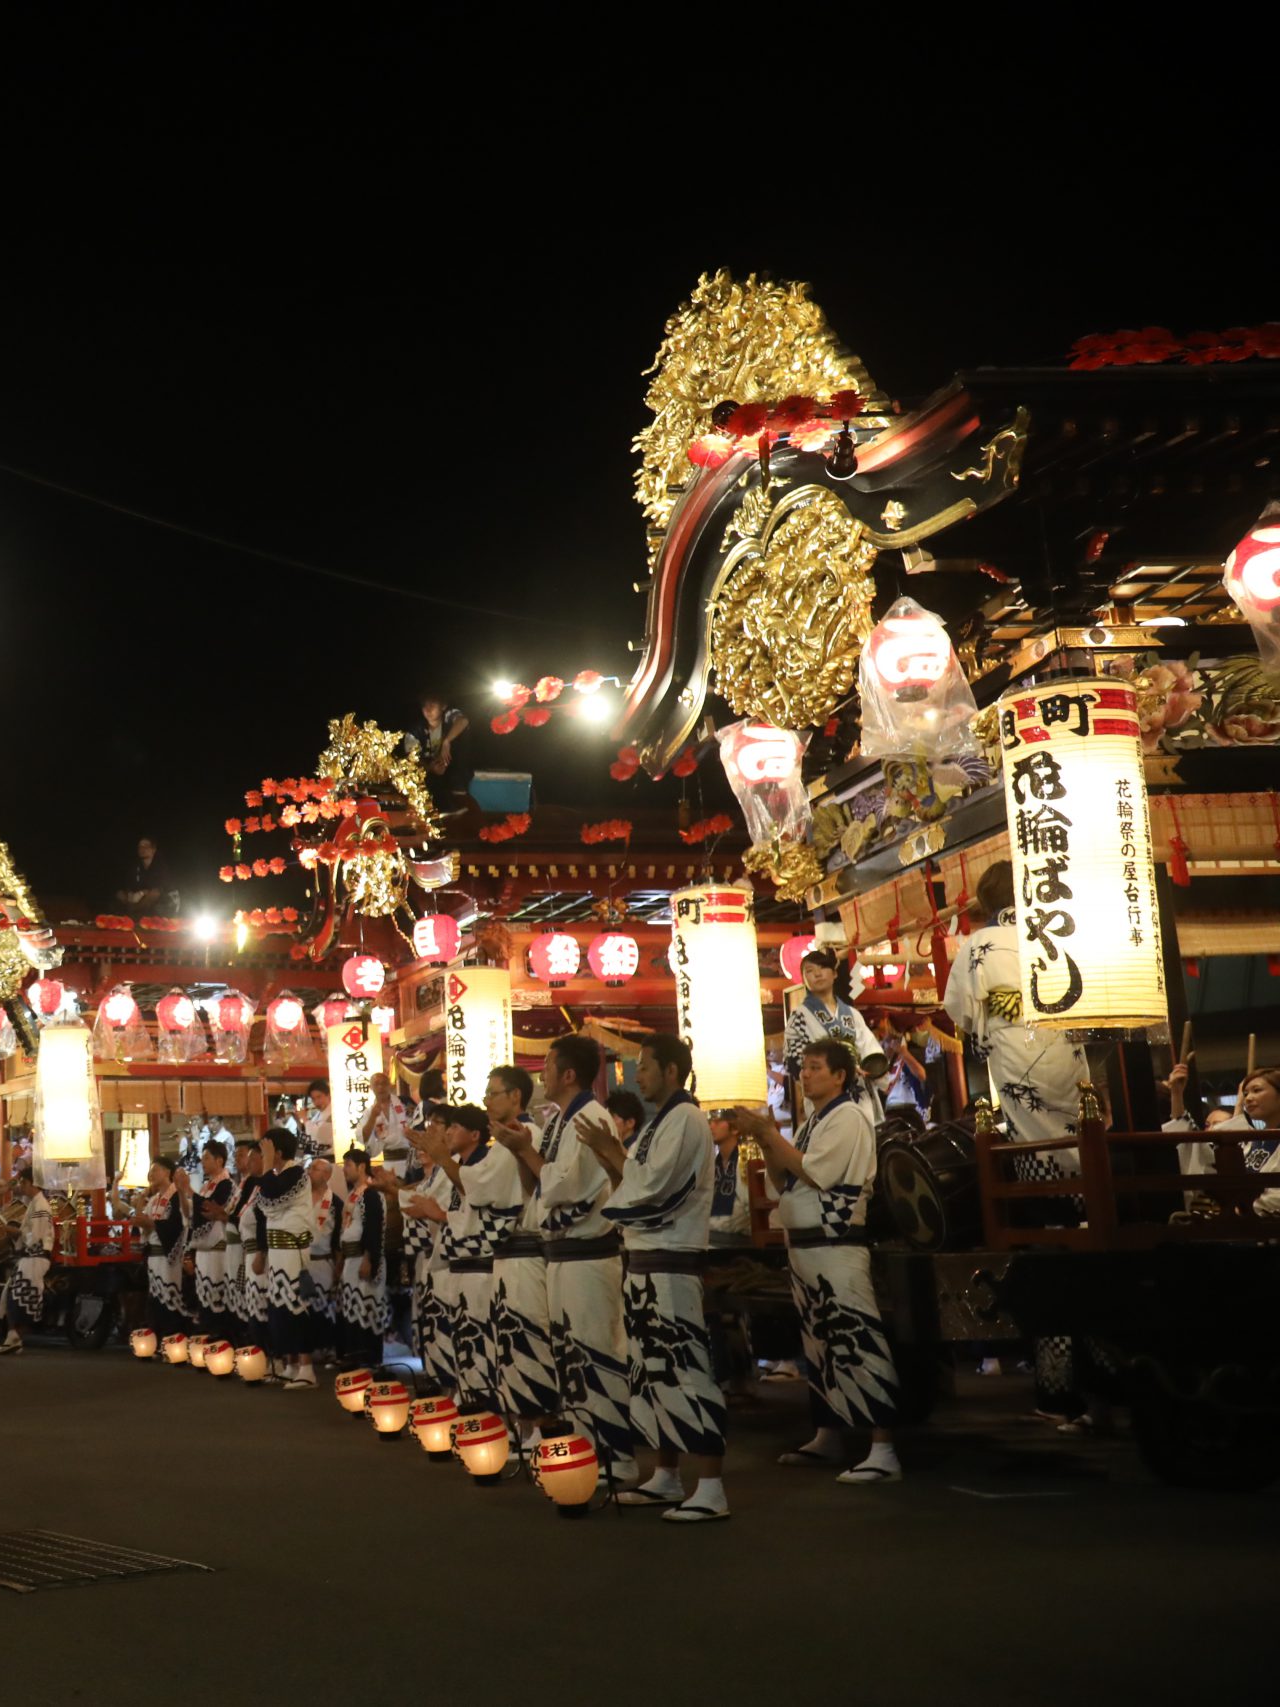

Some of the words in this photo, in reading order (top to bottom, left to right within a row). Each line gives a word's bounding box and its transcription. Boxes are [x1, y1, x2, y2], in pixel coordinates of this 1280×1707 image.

[1011, 750, 1084, 1015] 花輪ばやし
[1114, 778, 1145, 948] 花輪祭の屋台行事
[550, 1442, 569, 1458] 若
